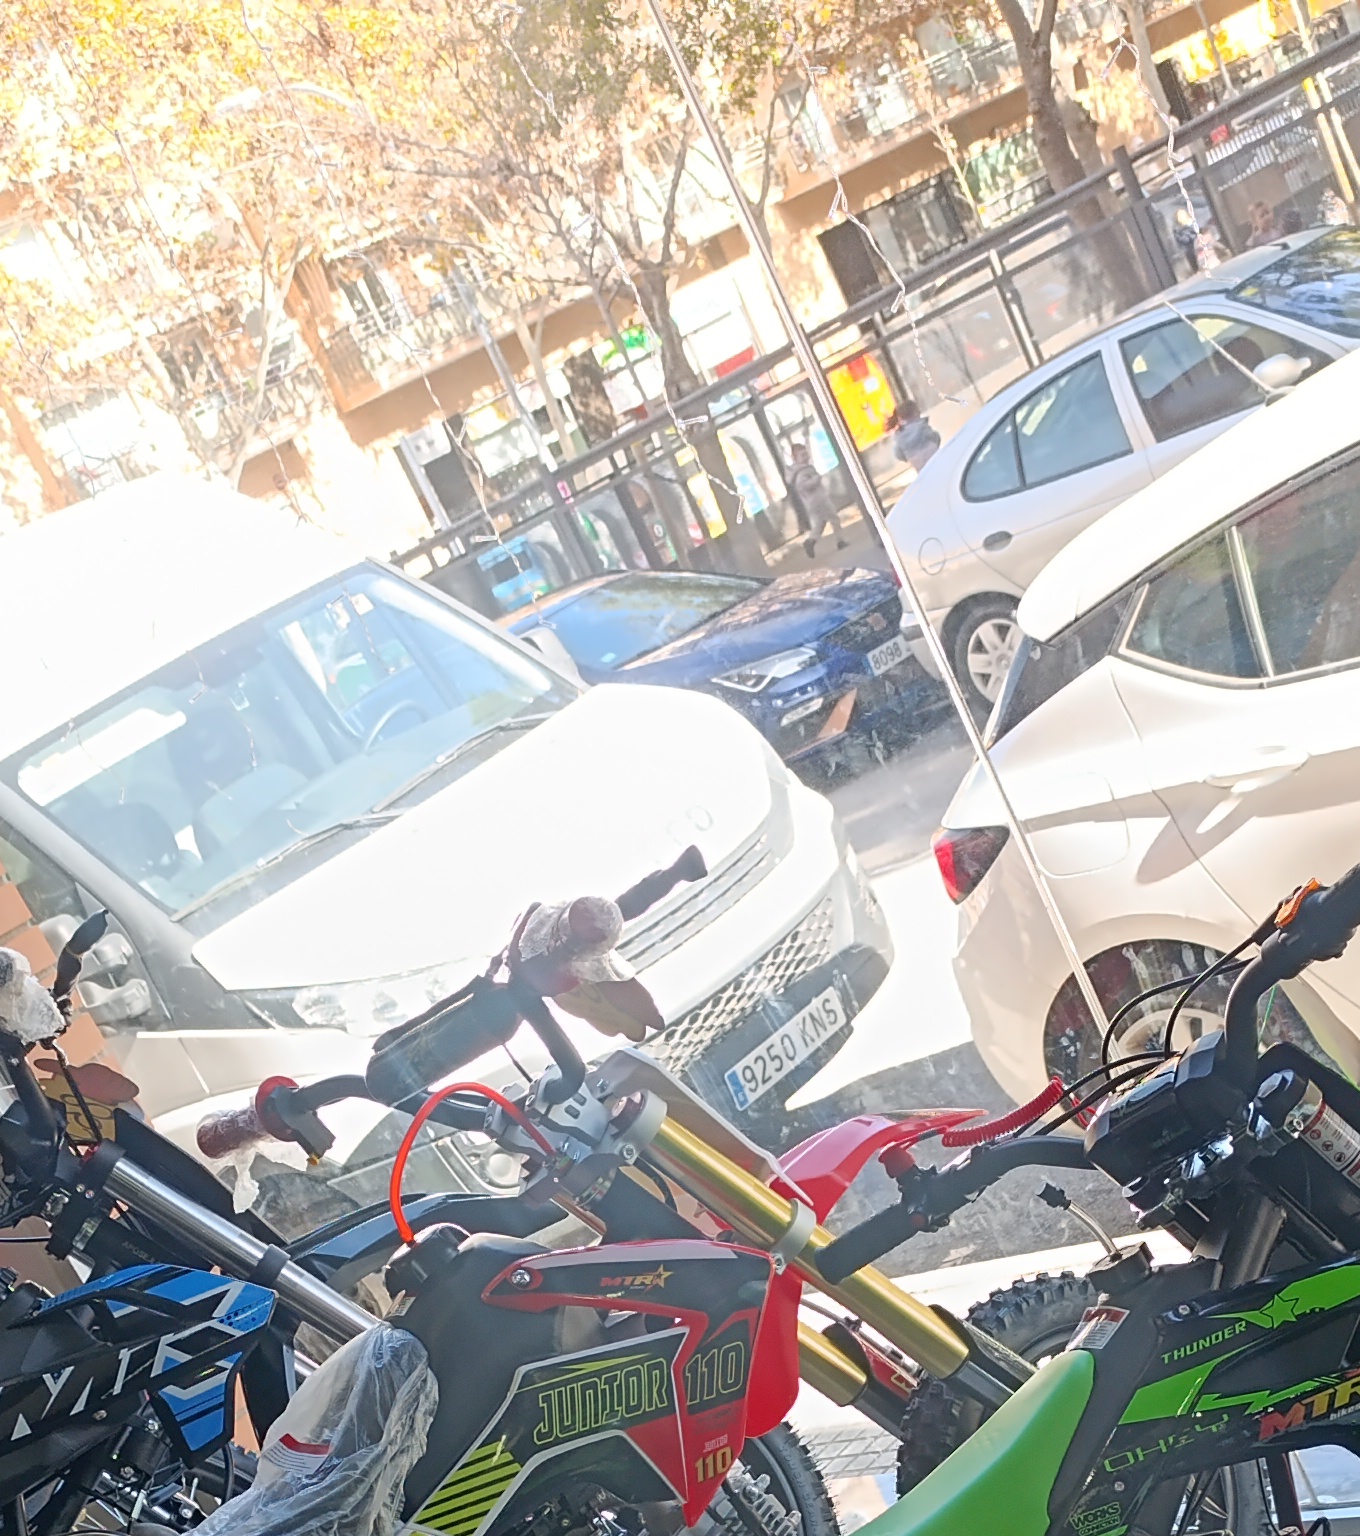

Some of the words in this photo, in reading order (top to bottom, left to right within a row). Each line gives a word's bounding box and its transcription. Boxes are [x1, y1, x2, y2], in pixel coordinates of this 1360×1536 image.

[872, 642, 903, 670] 8098
[742, 1033, 796, 1093] 9250
[799, 997, 839, 1047] KNS
[1161, 1320, 1247, 1364] THUNDER
[533, 1358, 668, 1445] JUNIOR
[686, 1341, 744, 1406] 110
[695, 1446, 732, 1483] 110
[1071, 1503, 1120, 1529] WORKS
